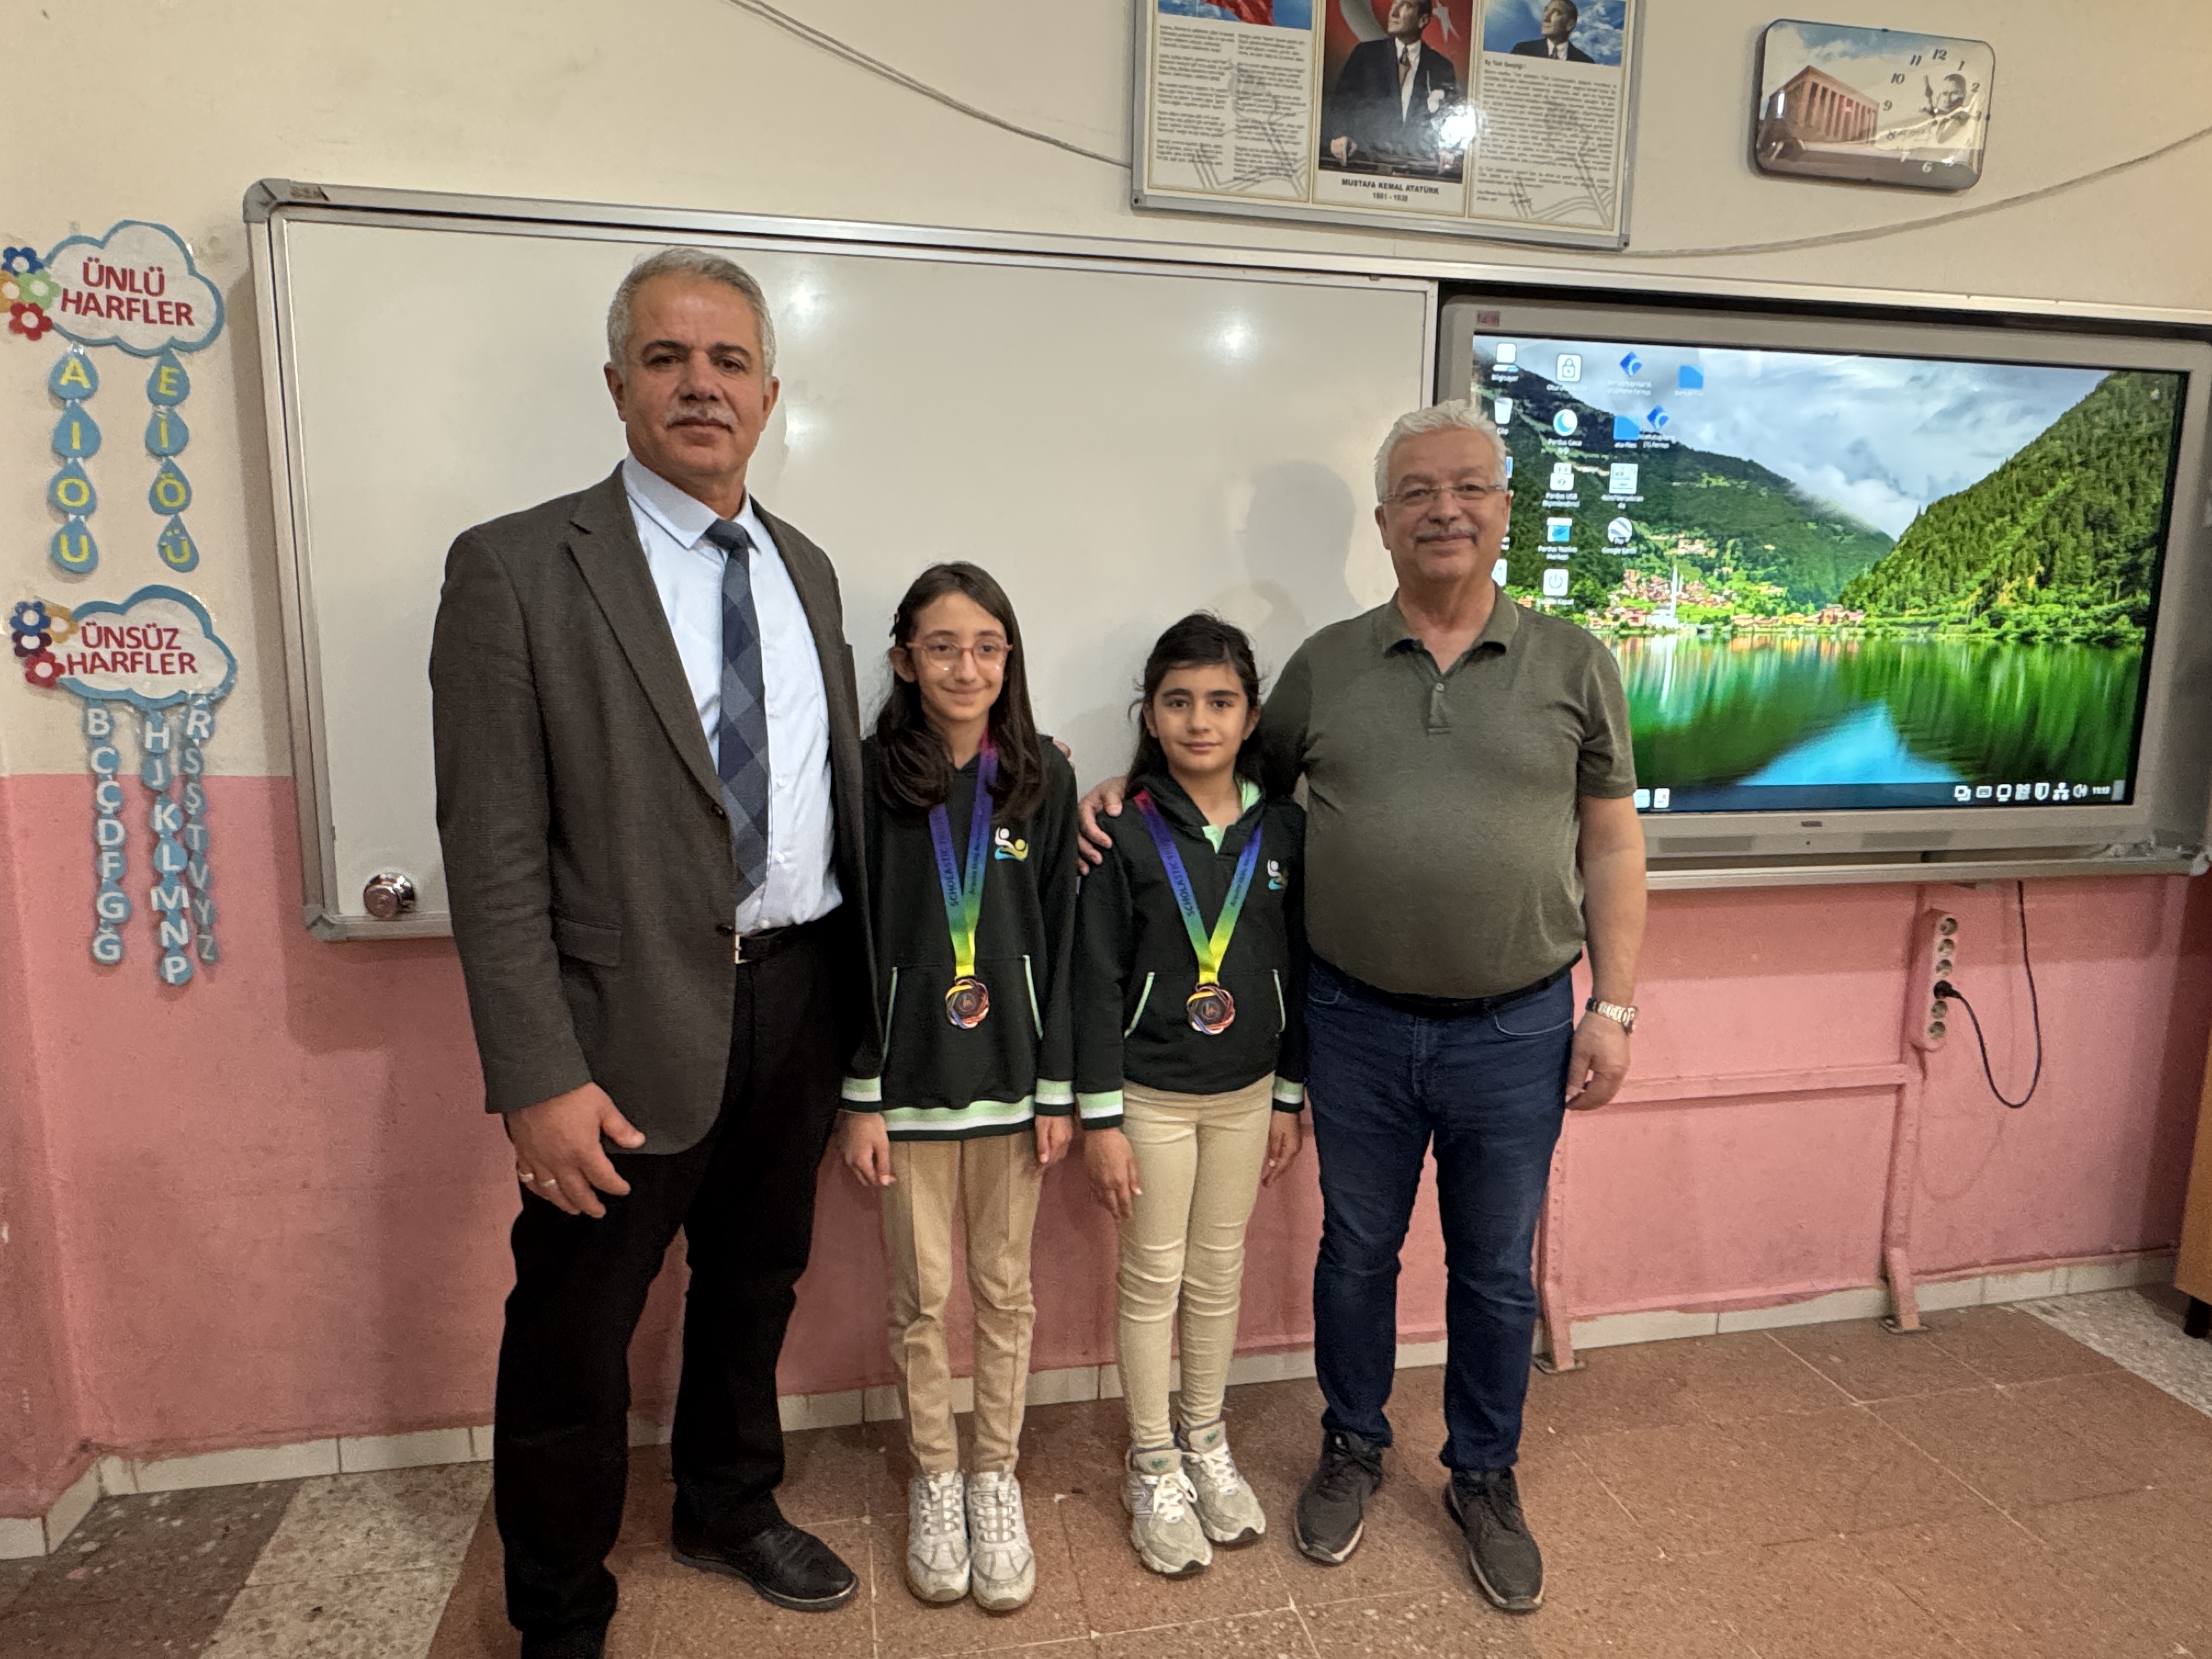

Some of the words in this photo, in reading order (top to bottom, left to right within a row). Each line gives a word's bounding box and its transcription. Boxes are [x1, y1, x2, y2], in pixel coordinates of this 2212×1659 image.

[1910, 55, 1922, 66] 11
[1932, 49, 1948, 61] 12
[1957, 60, 1965, 71] 1
[1891, 73, 1905, 84] 10
[1971, 82, 1980, 93] 2
[1883, 100, 1892, 111] 9
[1922, 162, 1932, 173] 6
[1342, 178, 1376, 189] MUSTAFA
[1378, 182, 1403, 191] KEMAL
[1405, 184, 1440, 195] ATATÜRK
[82, 257, 165, 297] ÜNLÜ
[60, 289, 194, 326] HARFLER
[59, 358, 91, 388] A
[159, 366, 180, 396] E
[57, 478, 90, 507] O
[157, 473, 185, 507] Ö
[59, 533, 89, 563] U
[163, 529, 190, 563] Ü
[81, 622, 182, 651] ÜNSÜZ
[66, 651, 199, 675] HARFLER
[88, 708, 110, 735] B
[145, 721, 170, 748] H
[187, 710, 211, 738] R
[91, 746, 115, 774] C
[152, 759, 164, 786] J
[183, 748, 200, 774] S
[96, 781, 120, 814] Ç
[154, 804, 177, 831] K
[98, 819, 125, 845] D
[187, 823, 205, 850] T
[101, 852, 120, 879] F
[162, 844, 180, 871] L
[189, 860, 208, 889] V
[940, 850, 959, 906] SCHOLASTIC
[150, 885, 190, 911] M
[1169, 860, 1195, 917] SCHOLASTIC
[97, 891, 125, 918] G
[194, 899, 212, 925] Y
[160, 919, 189, 947] N
[198, 935, 215, 960] Z
[165, 956, 187, 983] P
